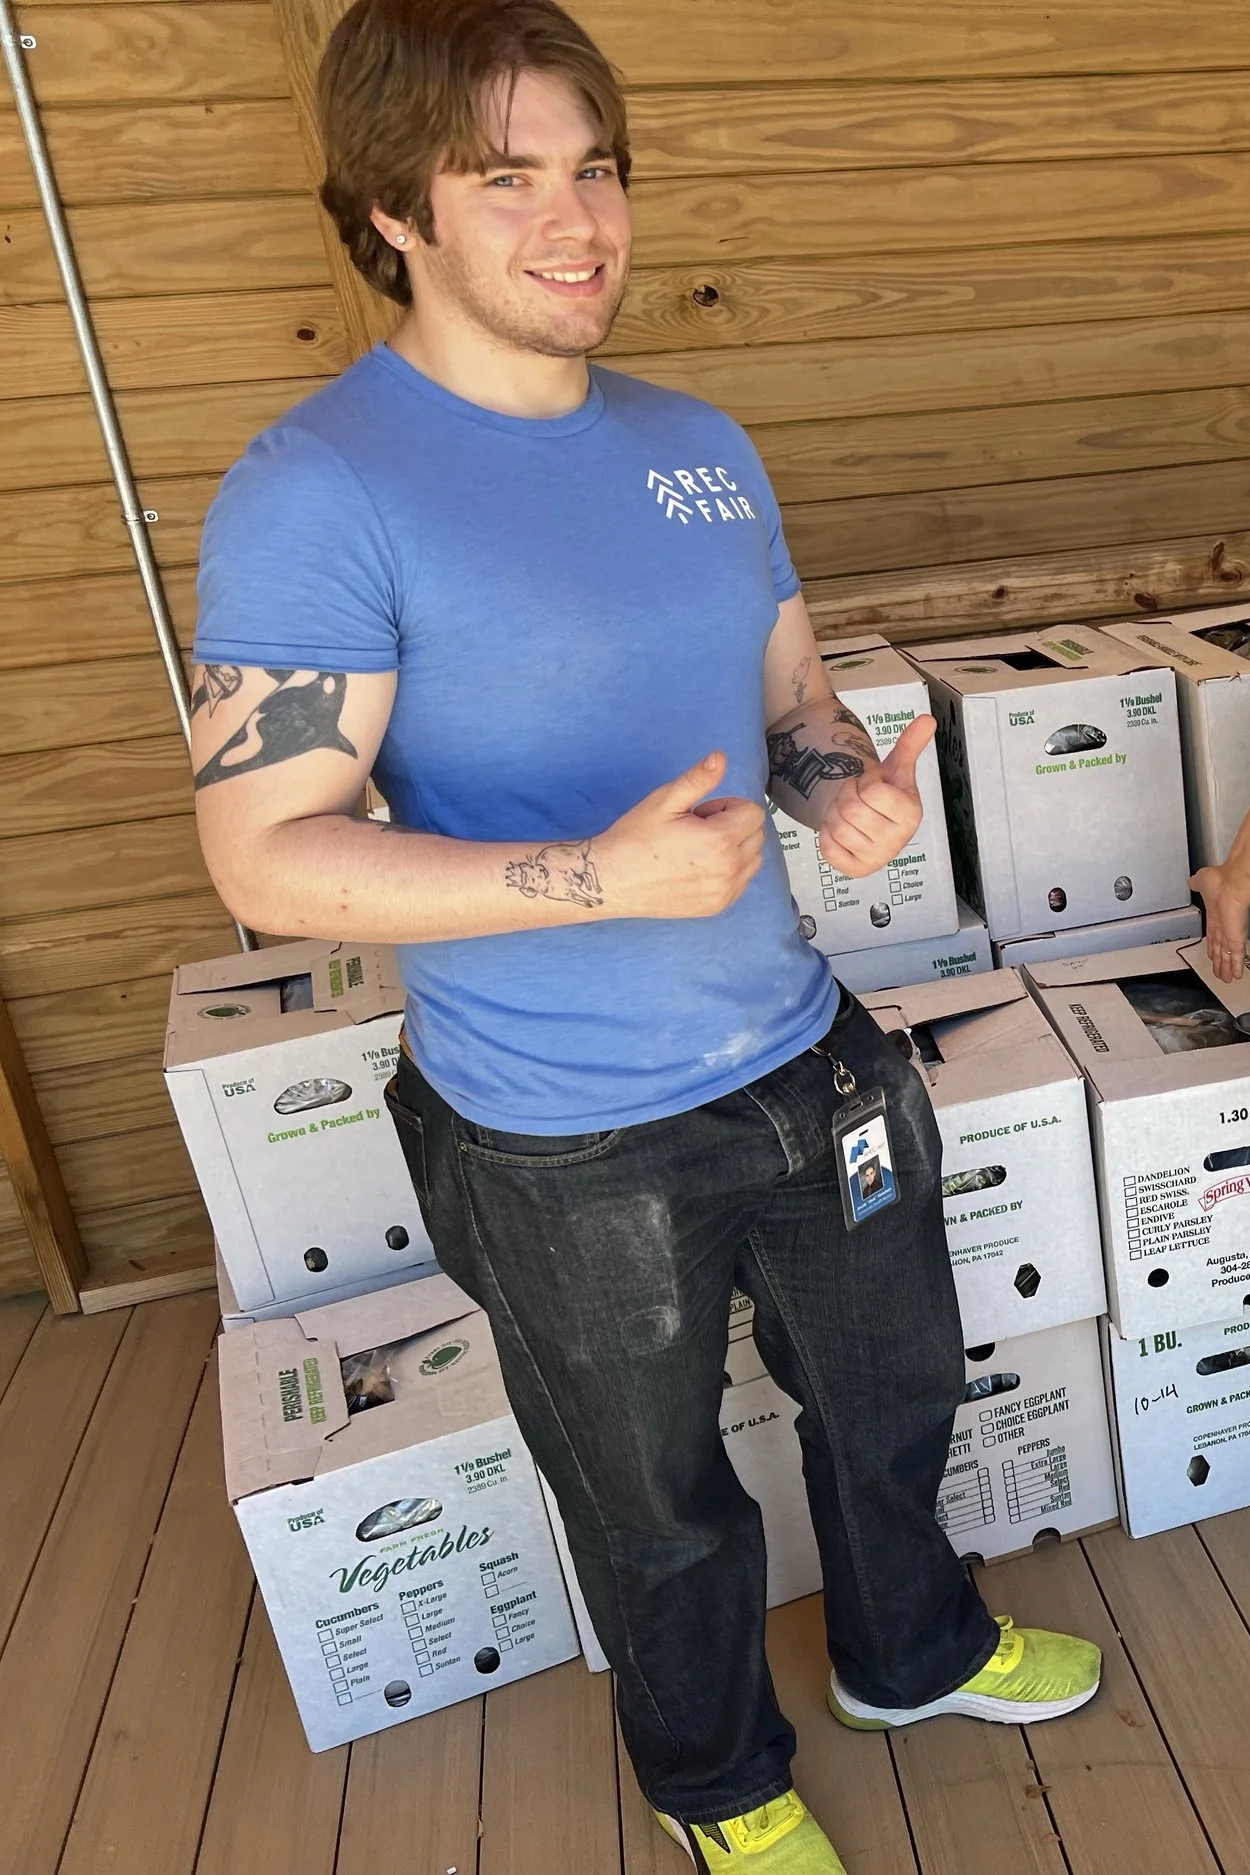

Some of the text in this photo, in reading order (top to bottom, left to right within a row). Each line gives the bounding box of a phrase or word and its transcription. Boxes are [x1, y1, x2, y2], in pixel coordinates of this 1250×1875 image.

[673, 466, 737, 495] REC
[694, 495, 756, 522] FAIR
[1135, 693, 1163, 706] Bushel
[884, 709, 915, 723] Bushel
[1009, 715, 1036, 726] USA
[1126, 706, 1157, 718] 3.90 DKL
[875, 725, 892, 736] 3.90
[1035, 753, 1127, 775] Grown Packed by
[948, 951, 977, 965] Bushel
[372, 1058, 390, 1071] 3.90
[223, 1084, 257, 1097] USA
[1219, 1107, 1248, 1124] 1.30
[267, 1108, 381, 1144] Grown & Packed by
[959, 1116, 1062, 1145] PRODUCE OF U.S.A.
[1137, 1166, 1191, 1184] DANDELION
[1138, 1176, 1197, 1194] SWISSCHARD
[1204, 1180, 1245, 1205] Spring
[1139, 1188, 1190, 1204] RED SWISS.
[959, 1213, 968, 1223] &
[969, 1204, 1008, 1221] PACKED
[1010, 1200, 1023, 1211] BY
[1140, 1199, 1189, 1215] ESCAROLE
[1141, 1212, 1175, 1226] ENDIVE
[1142, 1214, 1214, 1236] CURLY PARSLEY
[983, 1236, 1019, 1249] PRODUCE
[1142, 1225, 1212, 1246] PLAIN PARSLEY
[983, 1250, 1004, 1261] 17042
[1143, 1237, 1211, 1257] LEAF LETTUCE
[1206, 1252, 1249, 1267] Augusta,
[1138, 1330, 1183, 1358] 1 BU.
[278, 1367, 304, 1423] PERISHABLE
[994, 1387, 1067, 1418] FANCY EGGPLANT
[1134, 1383, 1179, 1415] 10-14
[1186, 1397, 1219, 1414] GROWN
[1220, 1396, 1228, 1405] &
[731, 1421, 745, 1433] OF
[747, 1411, 780, 1427] U.S.A.
[996, 1399, 1070, 1431] CHOICE EGGPLANT
[997, 1427, 1025, 1443] OTHER
[1193, 1424, 1238, 1443] COPENHAVER
[1017, 1438, 1050, 1456] PEPPERS
[1193, 1434, 1238, 1451] LEBANON, PA
[475, 1448, 512, 1468] Bushel
[465, 1464, 506, 1484] 3.90 DKL
[943, 1459, 979, 1478] CUMBERS
[286, 1511, 316, 1525] Produce
[288, 1515, 326, 1532] USA
[379, 1528, 444, 1553] FARM FRESH
[328, 1524, 495, 1593] Vegetables
[479, 1552, 519, 1572] Squash
[497, 1566, 518, 1578] Acorn
[398, 1579, 444, 1601] Peppers
[418, 1592, 447, 1607] X-Large
[490, 1590, 538, 1614] Eggplant
[315, 1602, 380, 1629] Cucumbers
[421, 1608, 443, 1620] Large
[508, 1608, 530, 1621] Fancy
[335, 1613, 384, 1636] Super Select
[425, 1617, 456, 1632] Medium
[511, 1619, 536, 1633] Choice
[339, 1635, 362, 1648] Small
[428, 1631, 452, 1646] Select
[514, 1632, 535, 1645] Large
[343, 1647, 367, 1661] Select
[432, 1647, 447, 1657] Red
[346, 1661, 369, 1674] Large
[435, 1656, 461, 1670] Suntan
[350, 1675, 371, 1687] Plain
